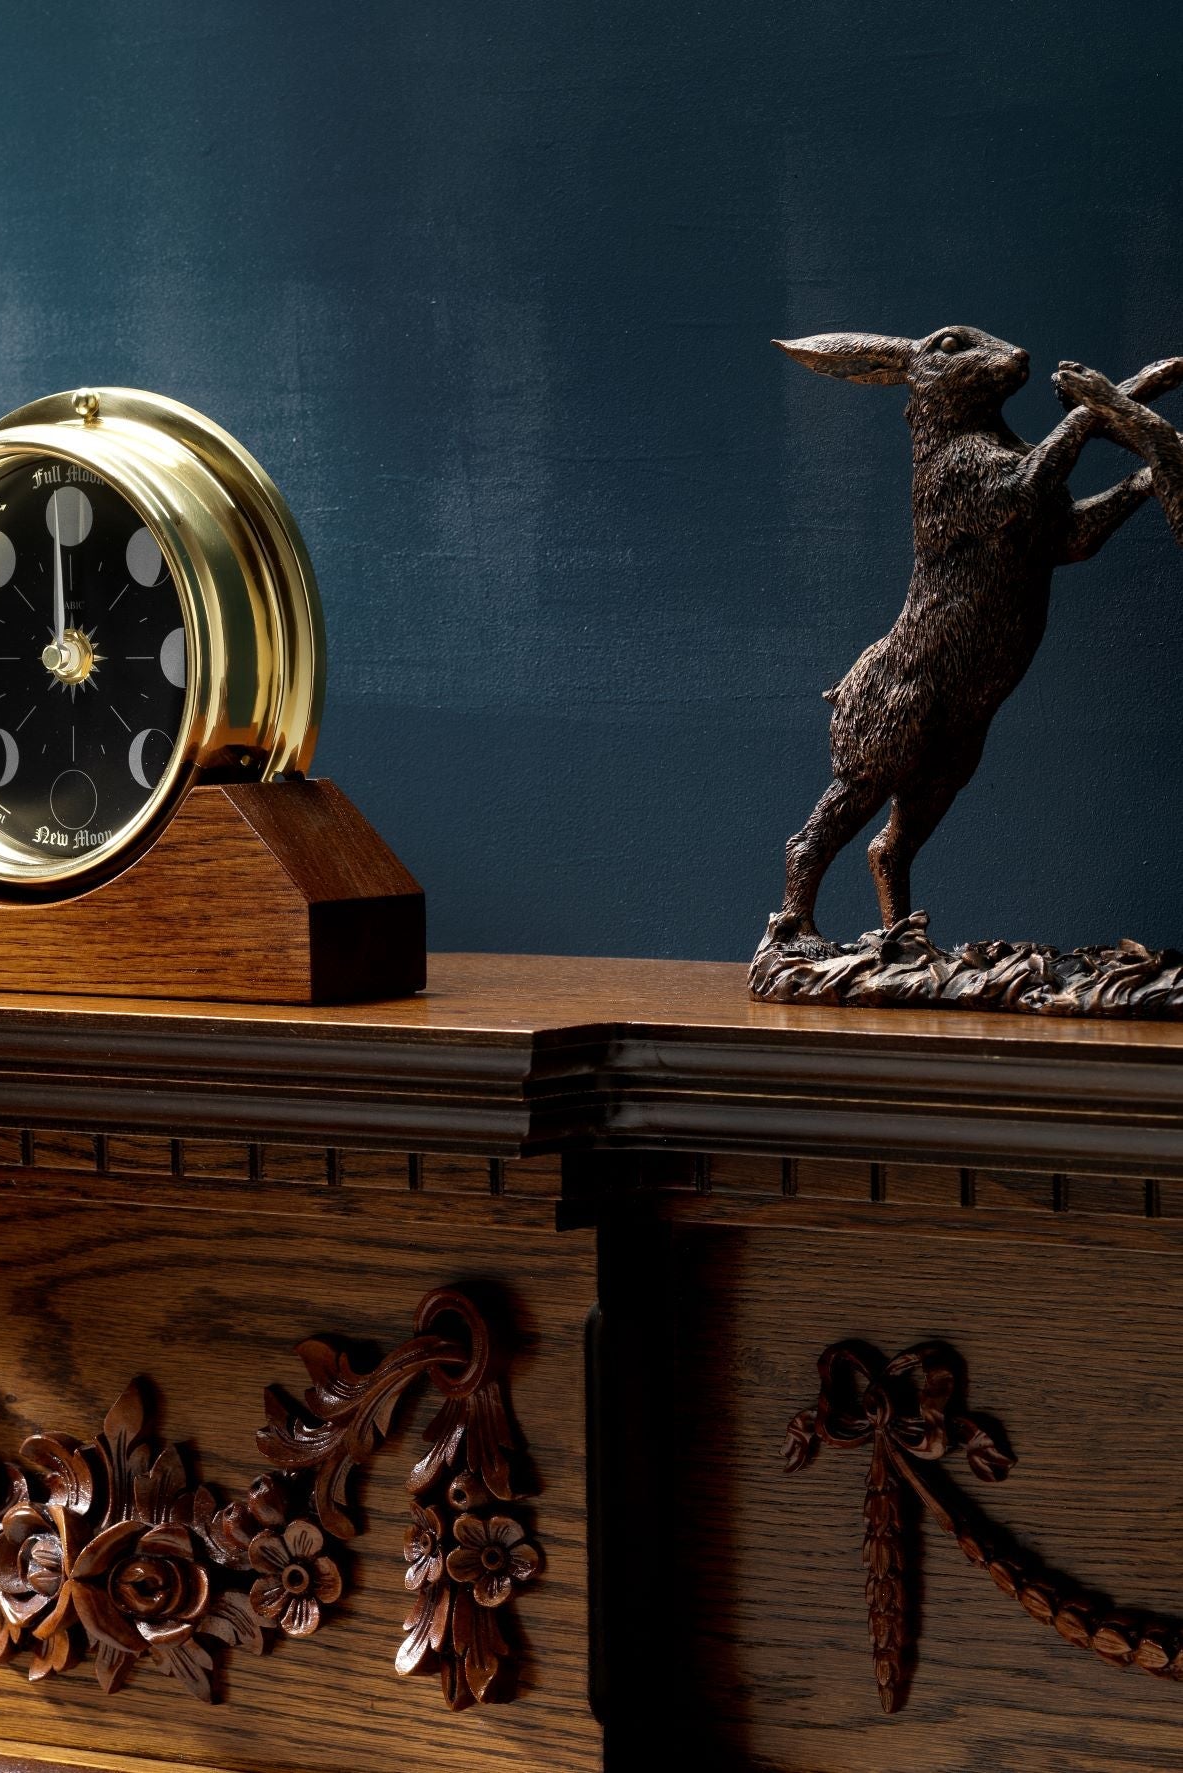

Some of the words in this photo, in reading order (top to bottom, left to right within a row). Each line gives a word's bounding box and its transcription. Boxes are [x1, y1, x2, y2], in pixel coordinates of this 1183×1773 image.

[32, 464, 61, 490] Full
[64, 464, 105, 486] Moon
[64, 600, 84, 610] ABIC
[31, 825, 69, 847] New
[72, 828, 114, 850] Moon
